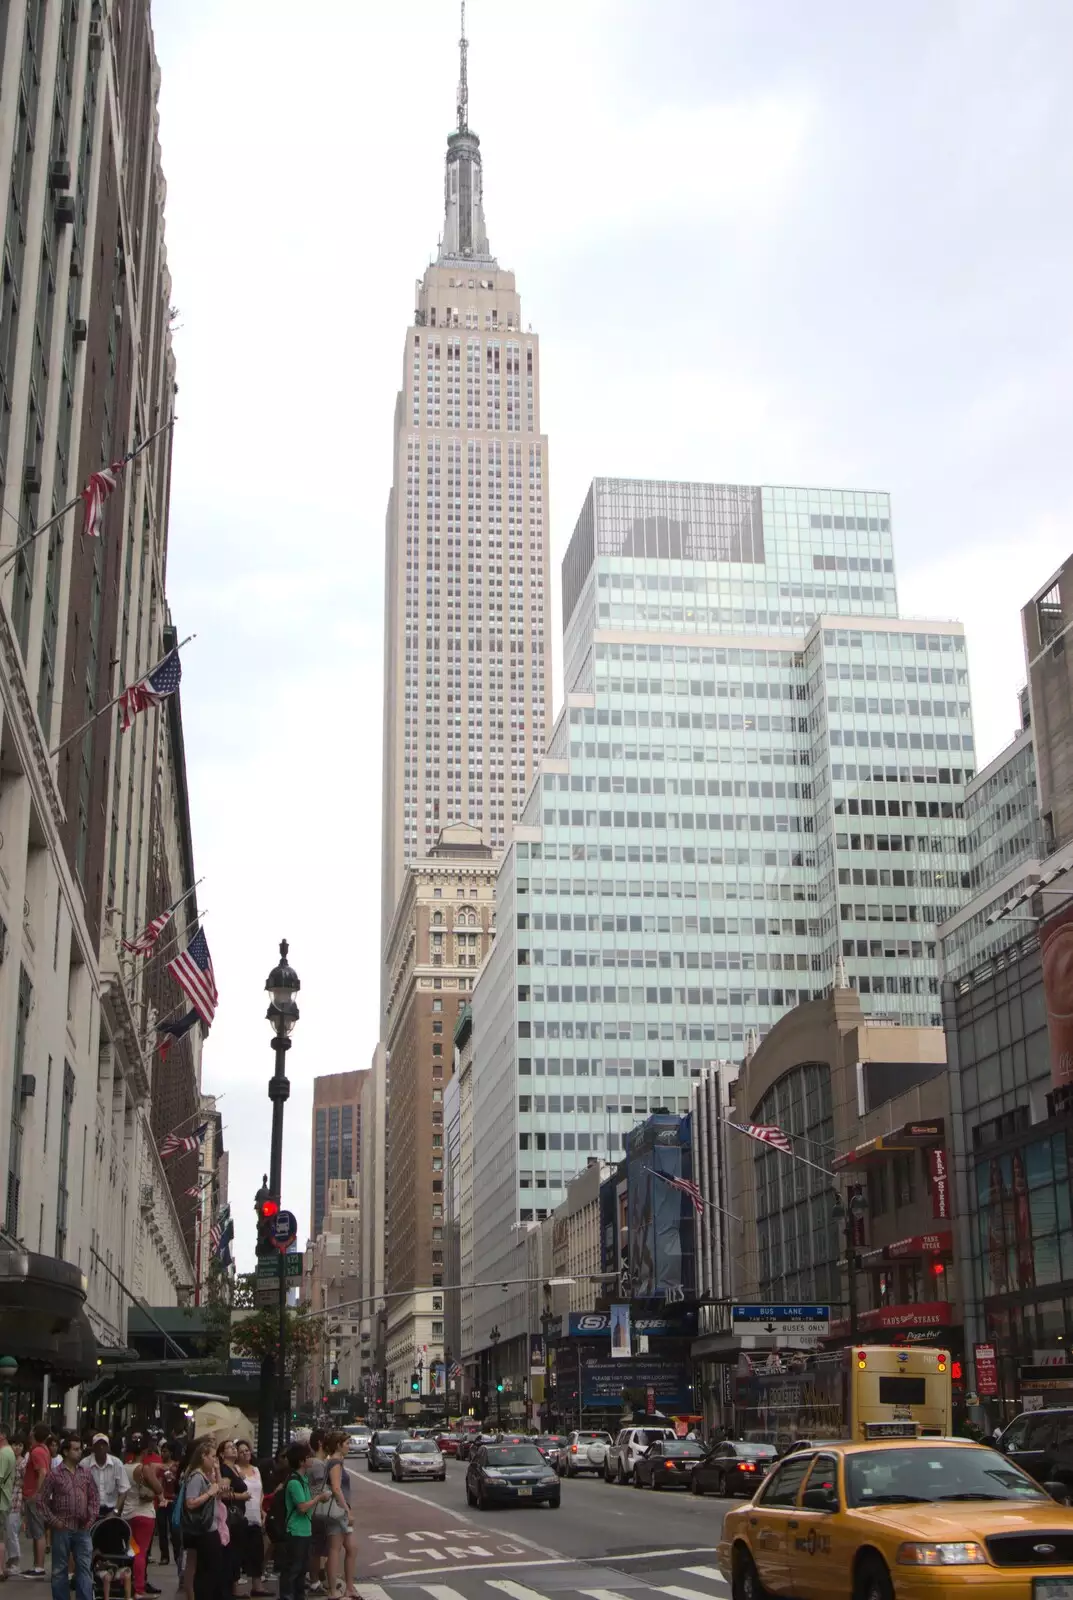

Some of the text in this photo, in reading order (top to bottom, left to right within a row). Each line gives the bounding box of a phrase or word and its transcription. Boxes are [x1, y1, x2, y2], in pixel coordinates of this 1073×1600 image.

[782, 1324, 825, 1332] BUSES ONLY
[471, 1391, 481, 1399] 112
[368, 1529, 491, 1543] BUS
[368, 1544, 526, 1567] ONLY
